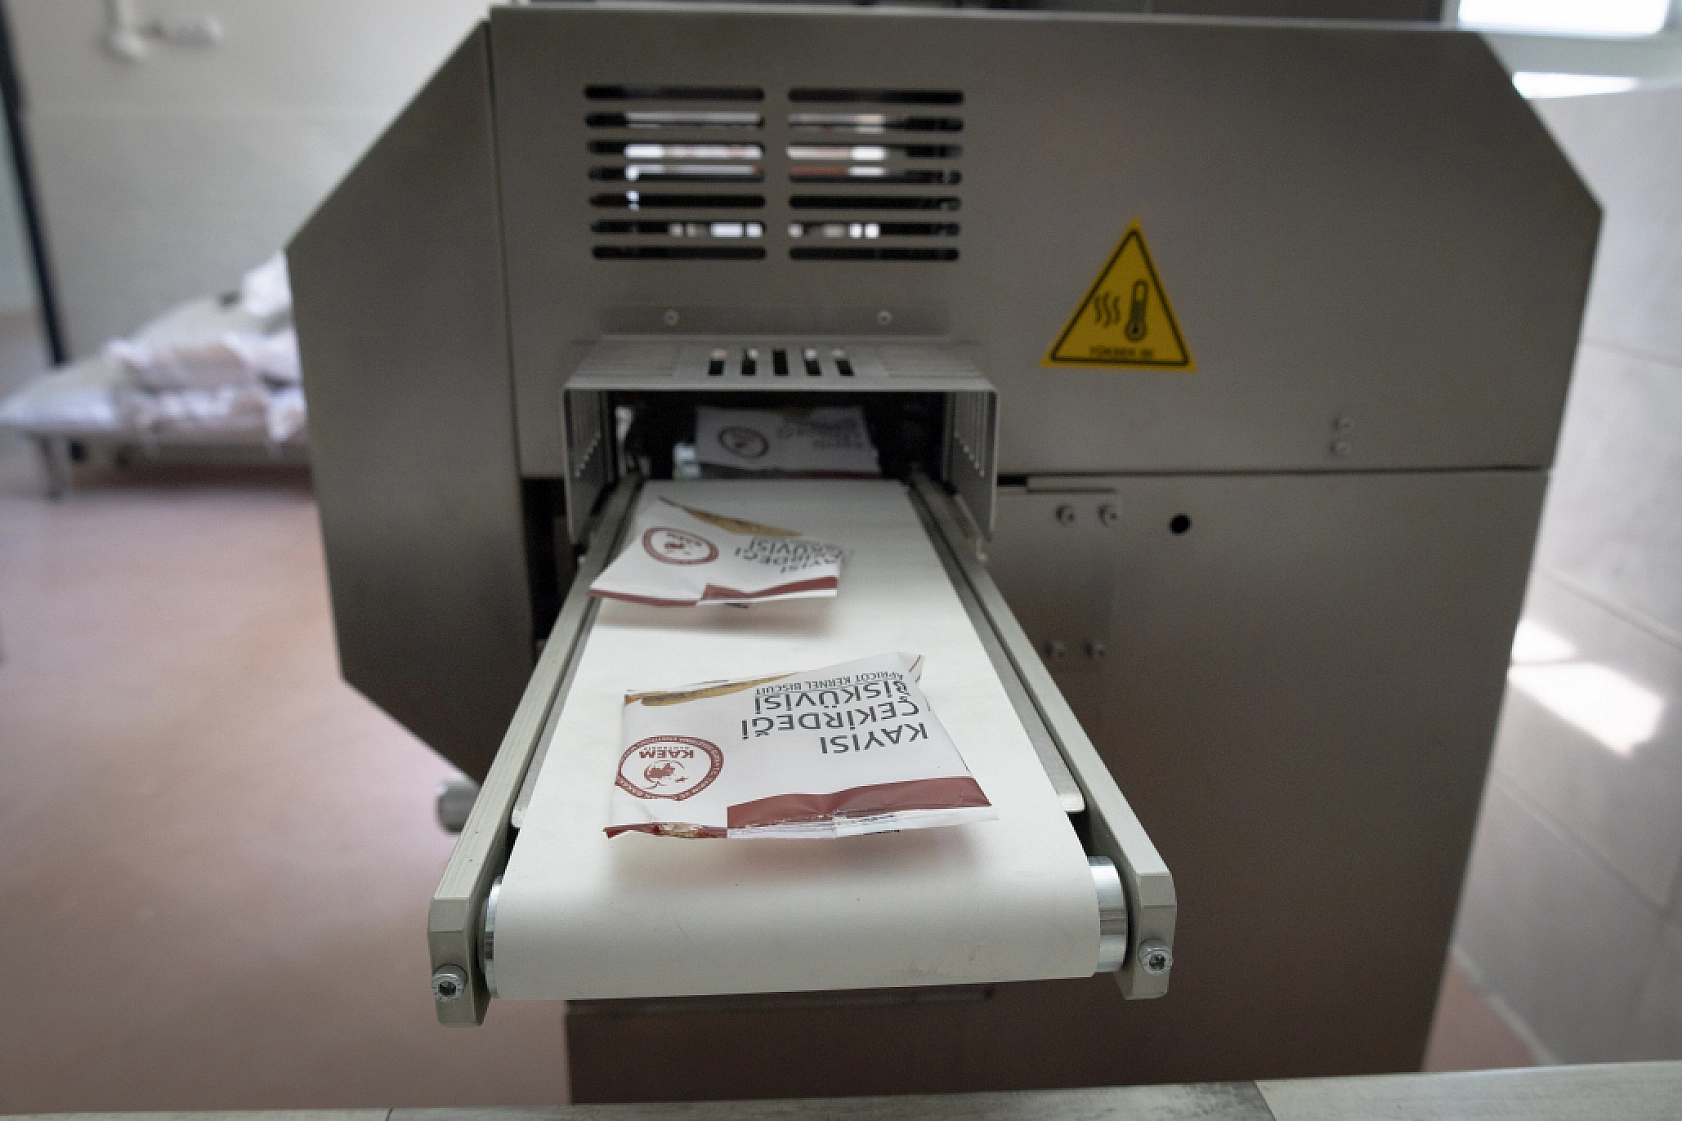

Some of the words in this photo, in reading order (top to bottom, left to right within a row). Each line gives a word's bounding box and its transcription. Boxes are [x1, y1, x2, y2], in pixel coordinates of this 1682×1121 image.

[804, 676, 851, 689] KERNEL
[855, 671, 904, 683] APRICOT
[755, 682, 802, 695] BISCUIT
[741, 696, 920, 740] ÇEKİRDEĞİ
[819, 722, 929, 754] KAYISI
[639, 749, 695, 759] KAEM
